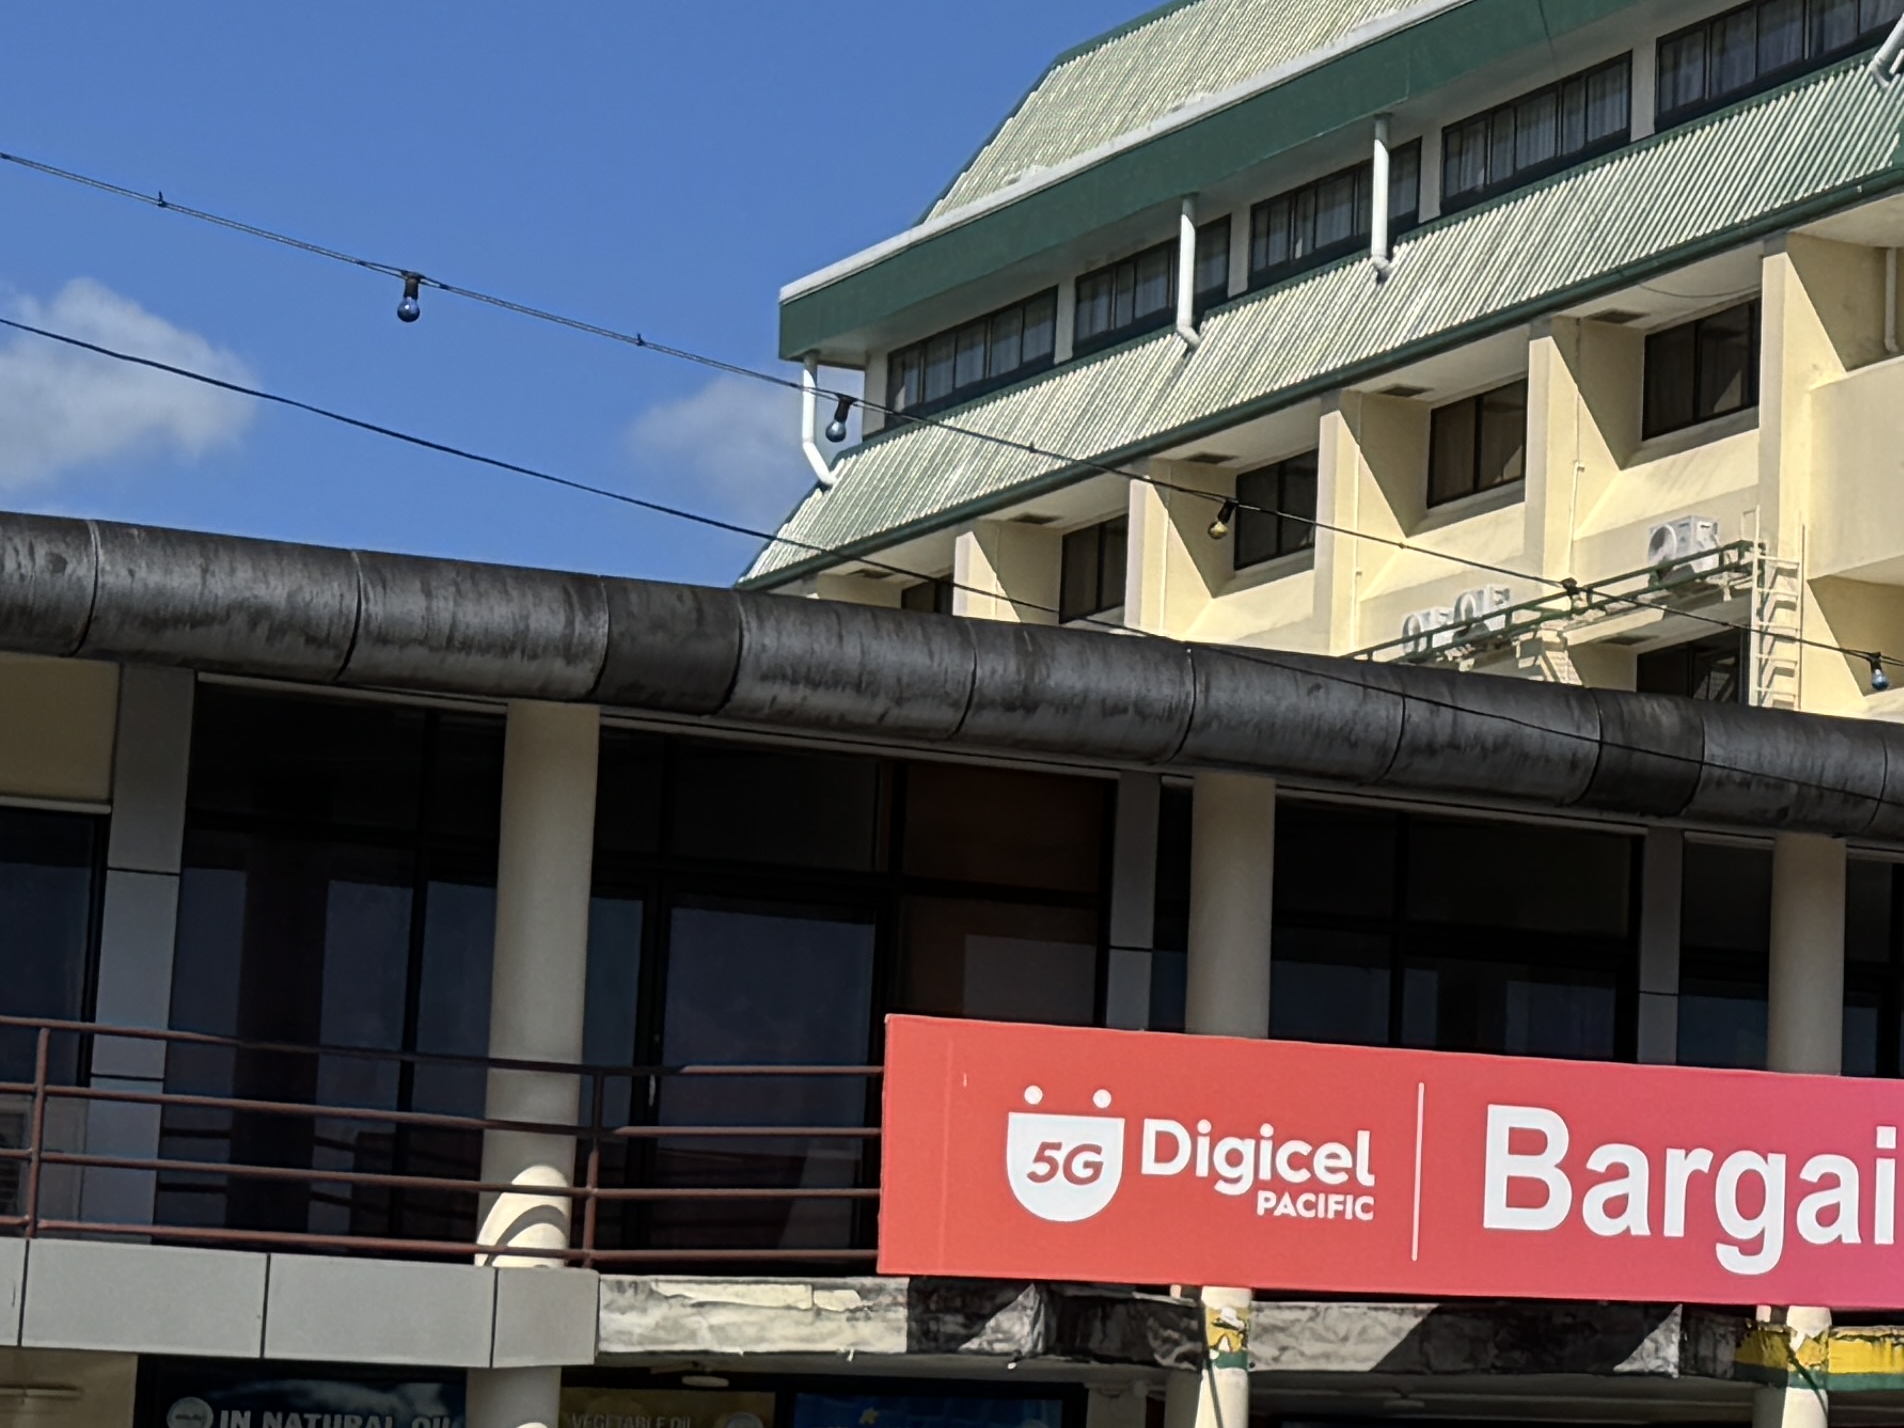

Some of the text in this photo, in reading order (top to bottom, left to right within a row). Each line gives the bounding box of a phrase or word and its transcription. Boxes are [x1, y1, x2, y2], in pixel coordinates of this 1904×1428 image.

[1026, 1140, 1106, 1186] 5G
[1141, 1117, 1377, 1197] Digicel
[1256, 1189, 1376, 1222] PACIFIC
